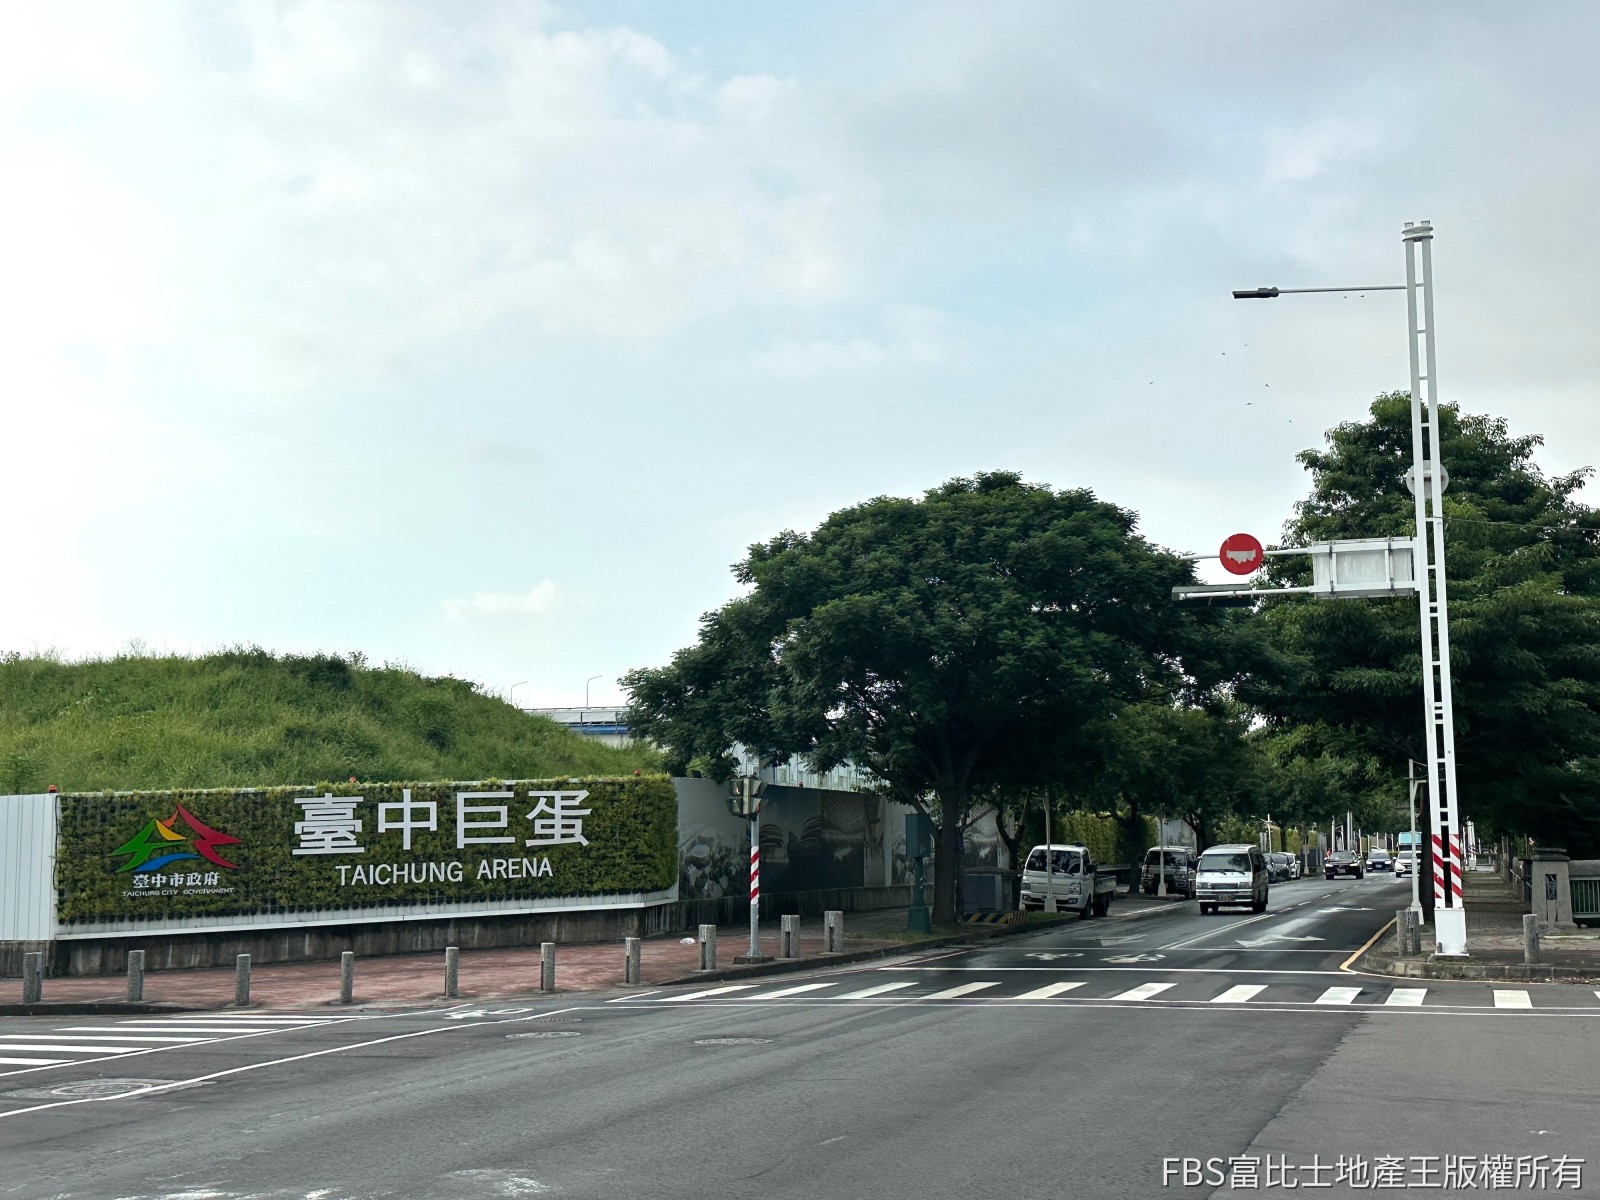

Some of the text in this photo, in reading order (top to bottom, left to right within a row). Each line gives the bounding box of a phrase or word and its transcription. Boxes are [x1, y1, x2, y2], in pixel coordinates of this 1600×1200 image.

[292, 788, 592, 855] 臺中巨蛋
[133, 871, 220, 889] 臺中市政府
[335, 857, 553, 886] TAICHUNG ARENA
[161, 888, 179, 896] CITY
[182, 887, 235, 896] GOVERNMENT
